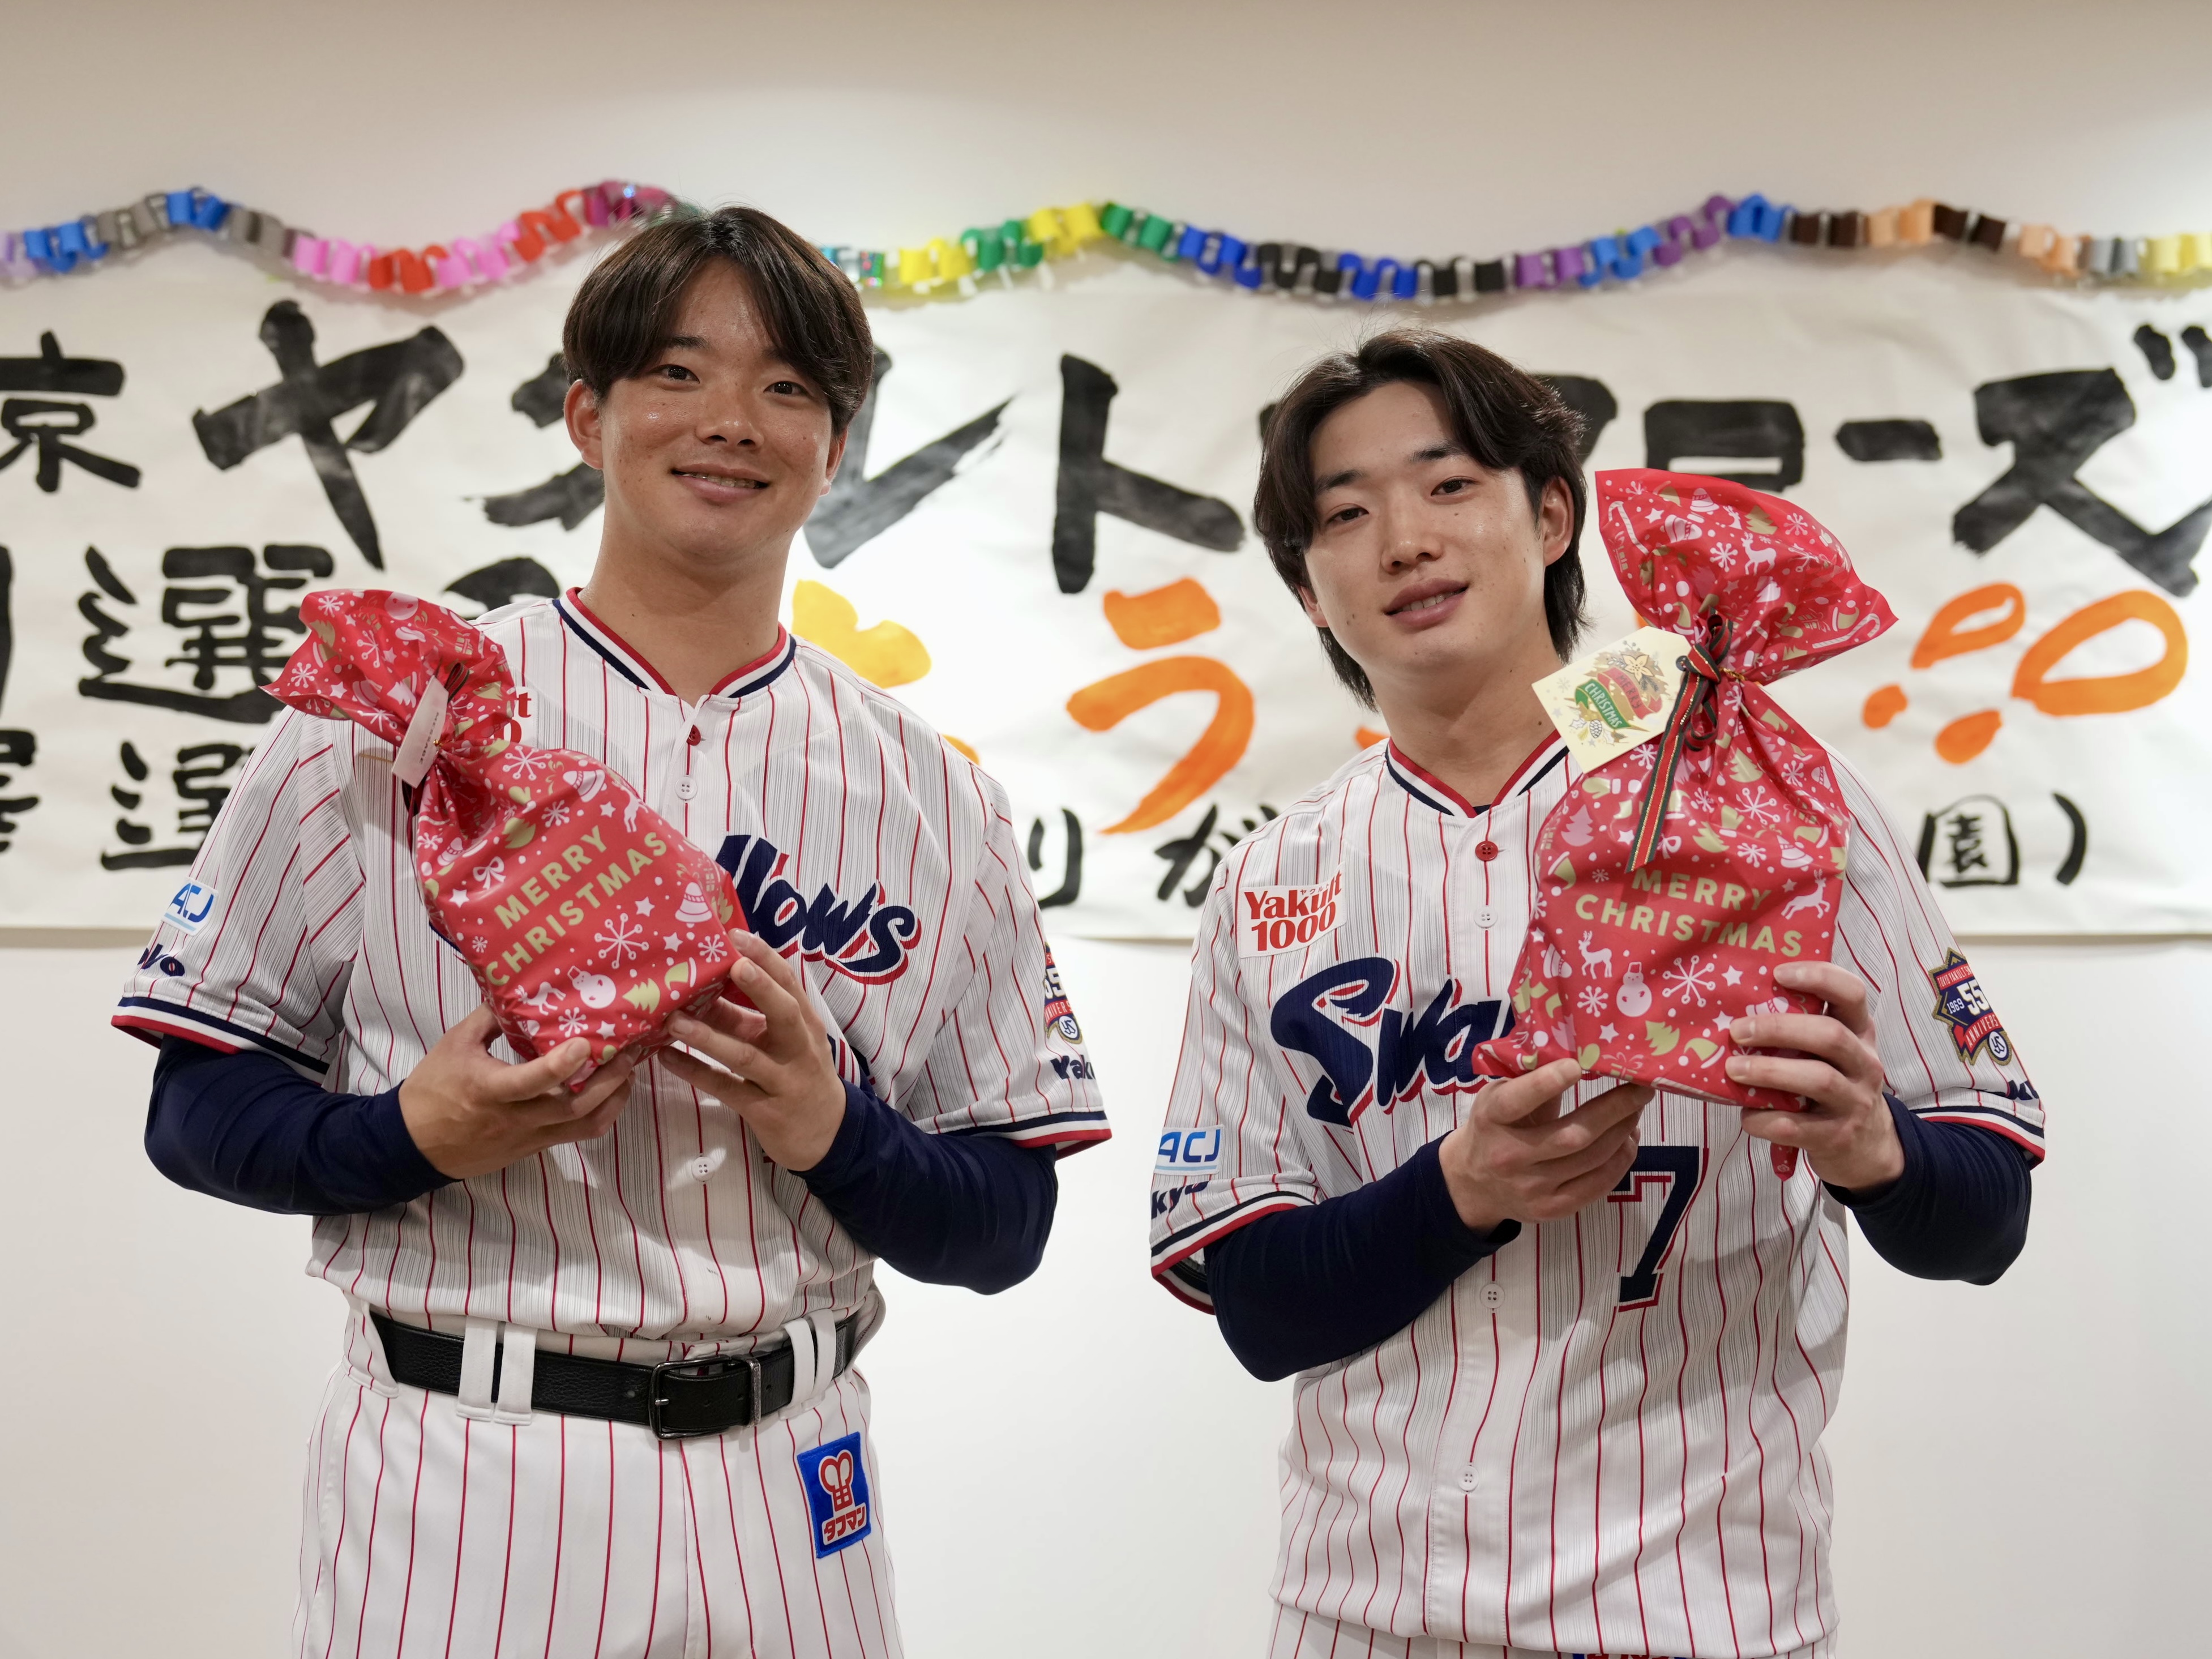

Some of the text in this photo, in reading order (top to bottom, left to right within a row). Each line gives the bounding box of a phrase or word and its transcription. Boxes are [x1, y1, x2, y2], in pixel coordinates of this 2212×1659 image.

[1584, 682, 1623, 728] CHRISTMAS
[1615, 674, 1641, 709] MERRY
[494, 825, 607, 929] MERRY
[1244, 869, 1342, 920] Yakult
[1299, 883, 1330, 896] ヤクルト
[1631, 868, 1772, 911] MERRY
[485, 831, 668, 986] CHRISTMAS
[1251, 901, 1336, 952] 1000
[1575, 893, 1803, 957] CHRISTMAS
[1946, 998, 1965, 1015] 1969
[1956, 978, 1991, 1016] 55
[823, 1505, 867, 1542] タフマン
